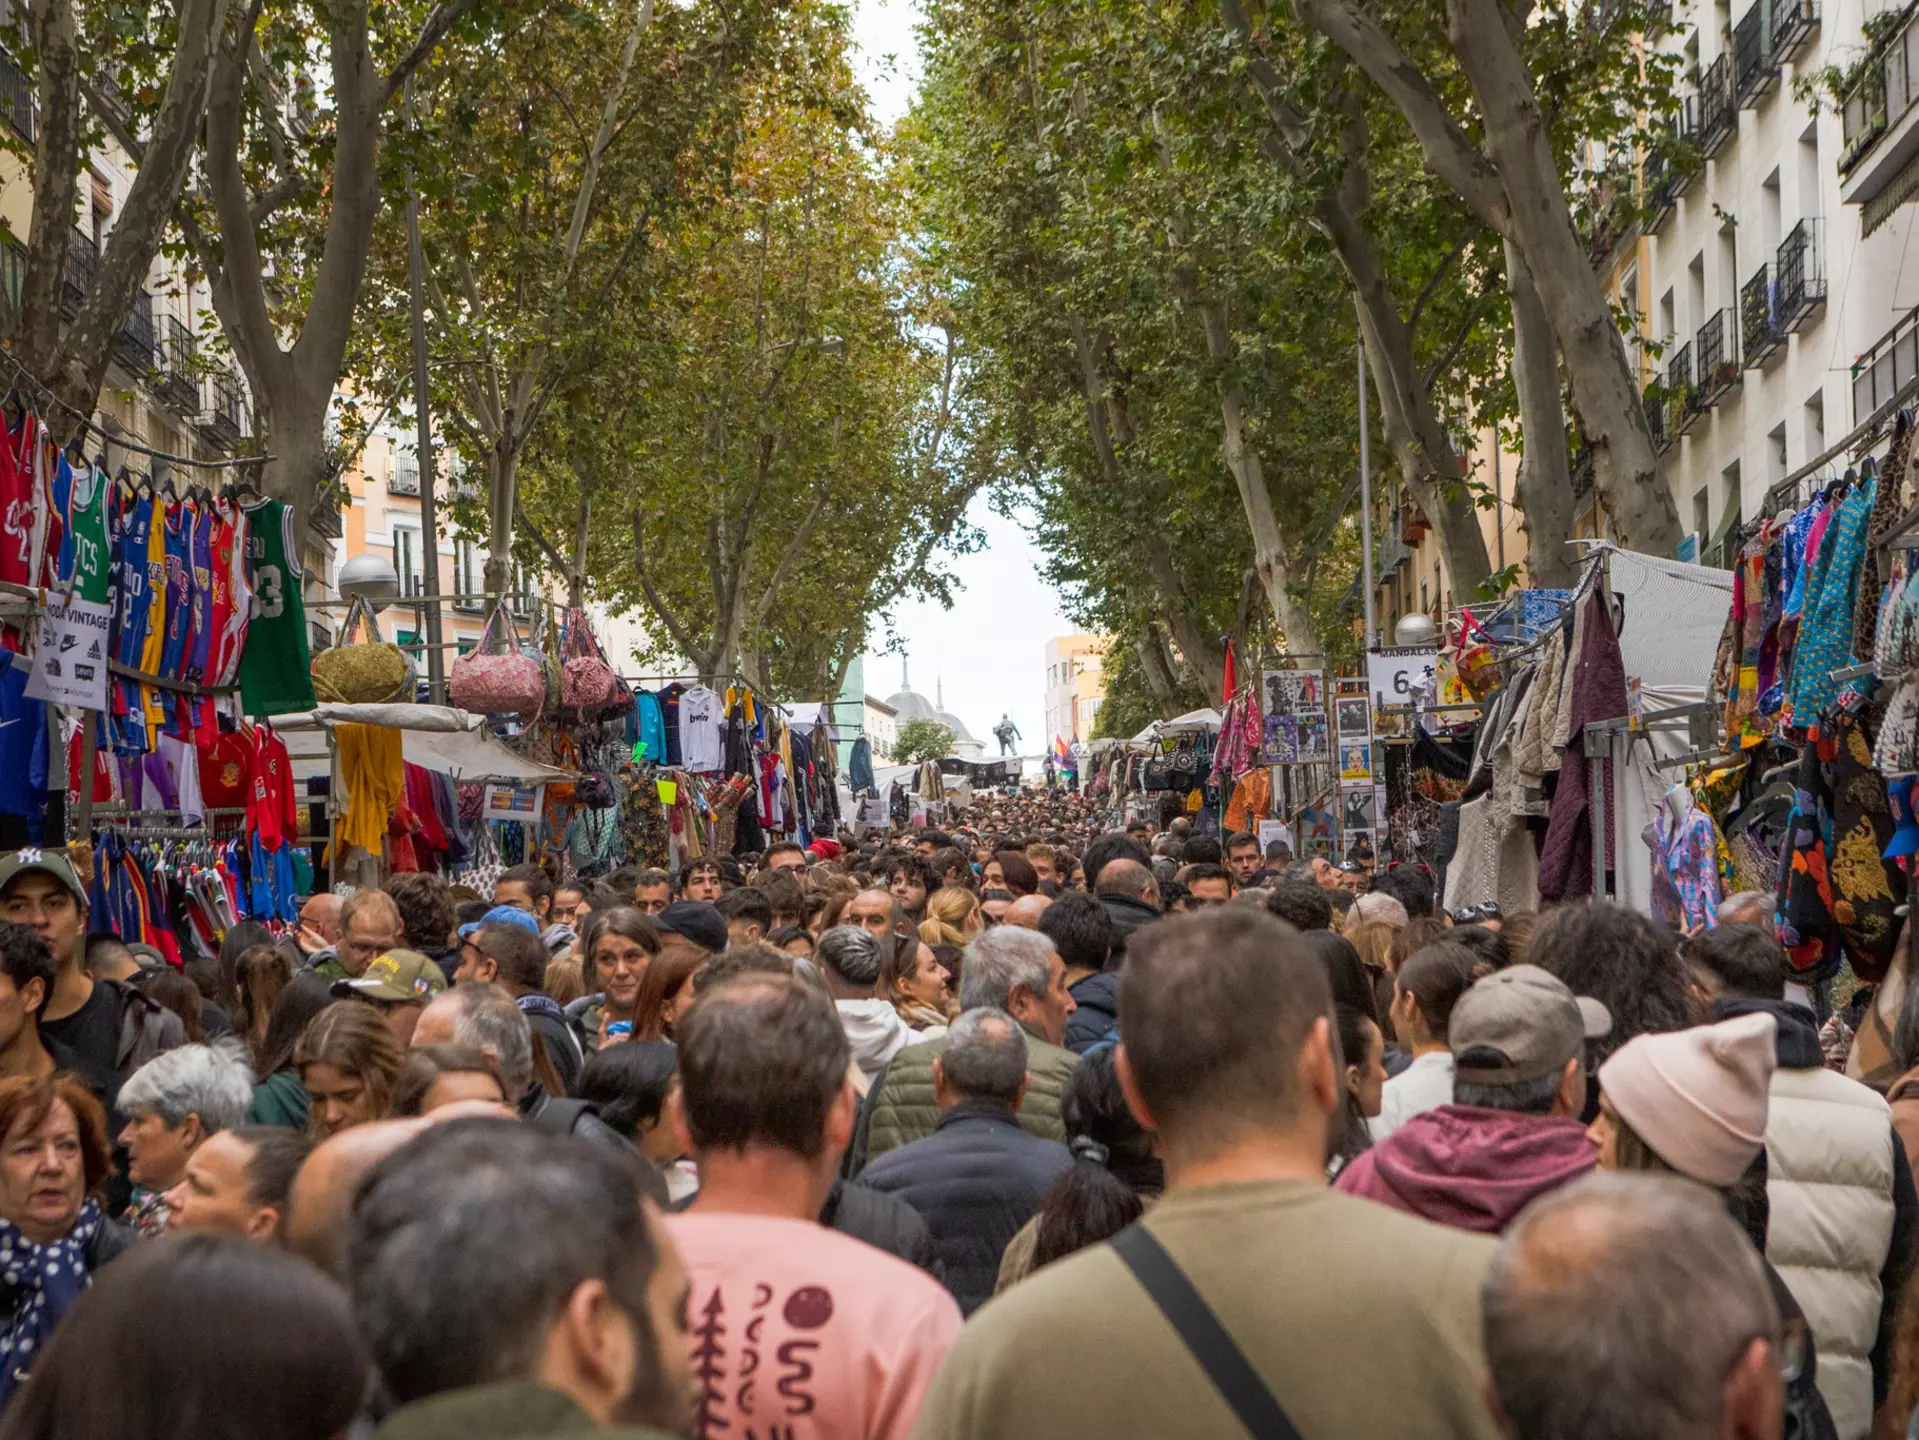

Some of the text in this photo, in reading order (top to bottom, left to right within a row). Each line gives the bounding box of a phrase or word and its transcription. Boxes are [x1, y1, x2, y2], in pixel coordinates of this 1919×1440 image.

[67, 608, 108, 630] VINTAGE
[1380, 647, 1437, 658] MANDALAS
[1393, 670, 1409, 695] 6
